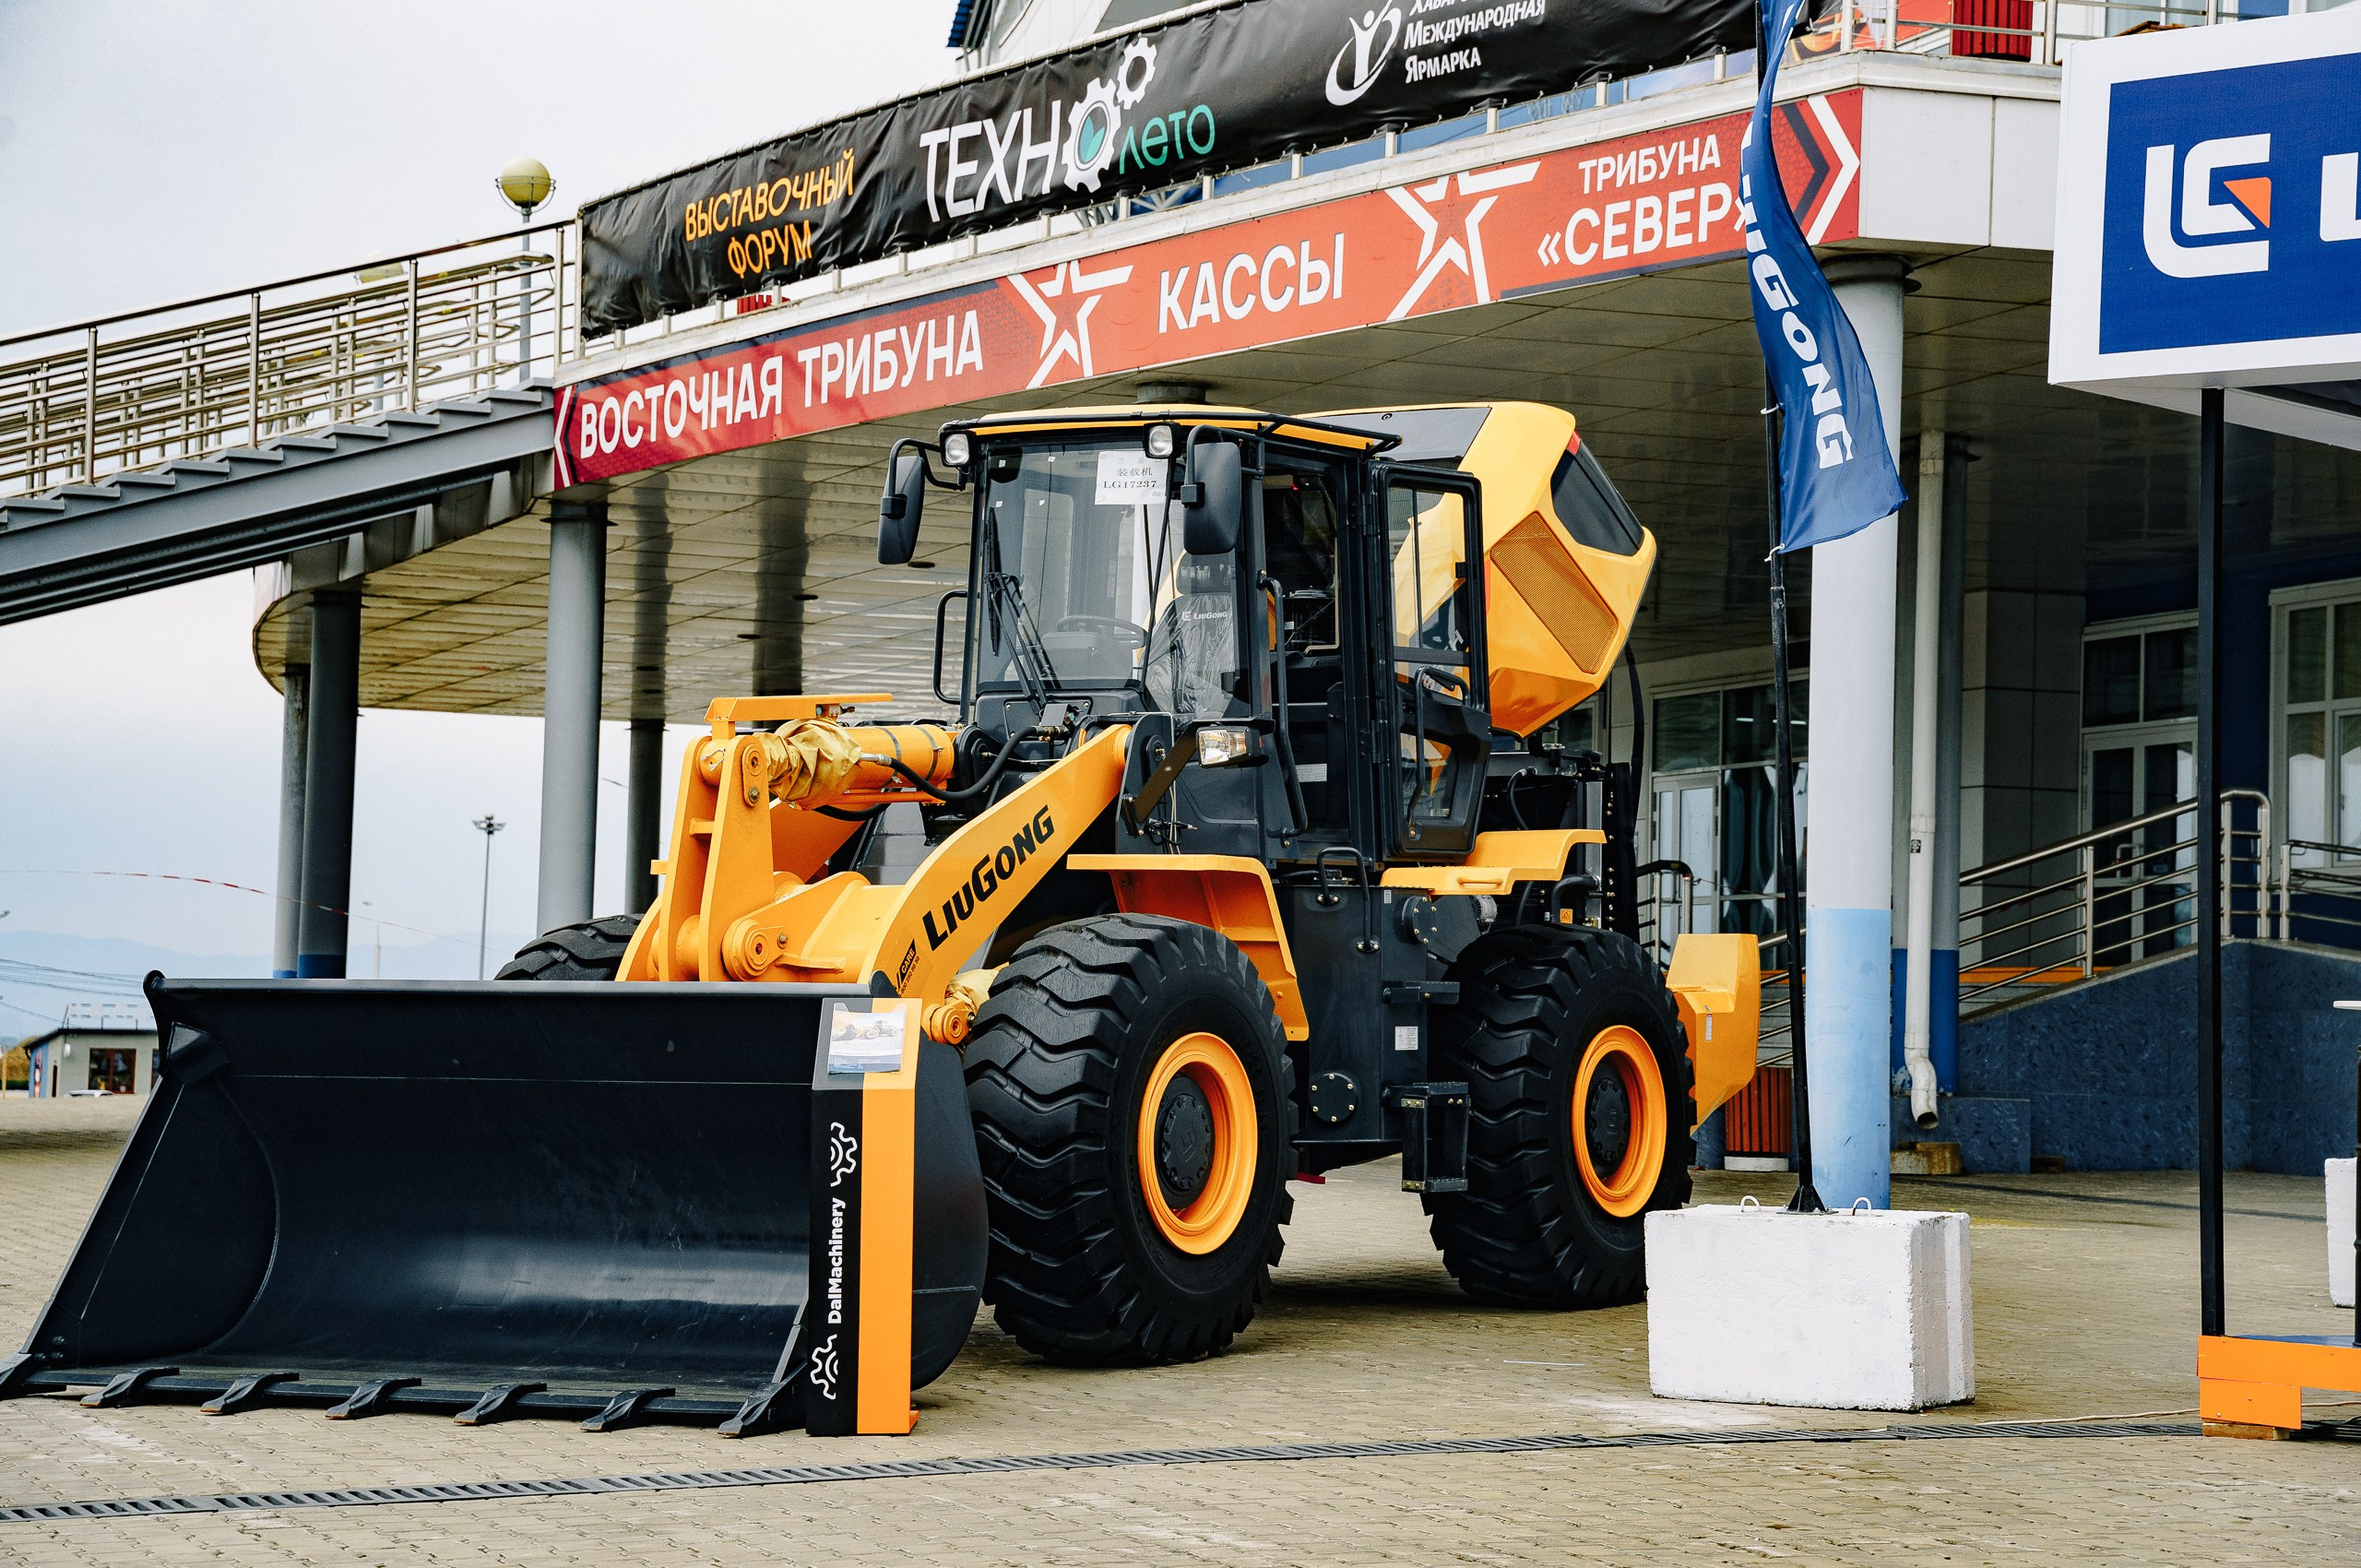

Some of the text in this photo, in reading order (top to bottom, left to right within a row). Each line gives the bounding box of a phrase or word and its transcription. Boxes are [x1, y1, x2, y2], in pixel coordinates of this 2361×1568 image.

[684, 148, 855, 243] ВЫСТАВОЧНЫЙ
[1578, 134, 1722, 195] ТРИБУНА
[726, 221, 813, 279] ФОРУМ
[1158, 232, 1345, 334] КАССЫ
[579, 309, 984, 460] ВОСТОЧНАЯ ТРИБУНА
[1103, 480, 1157, 489] LG17237
[901, 947, 916, 974] CARE
[827, 1196, 847, 1324] DalMachinery
